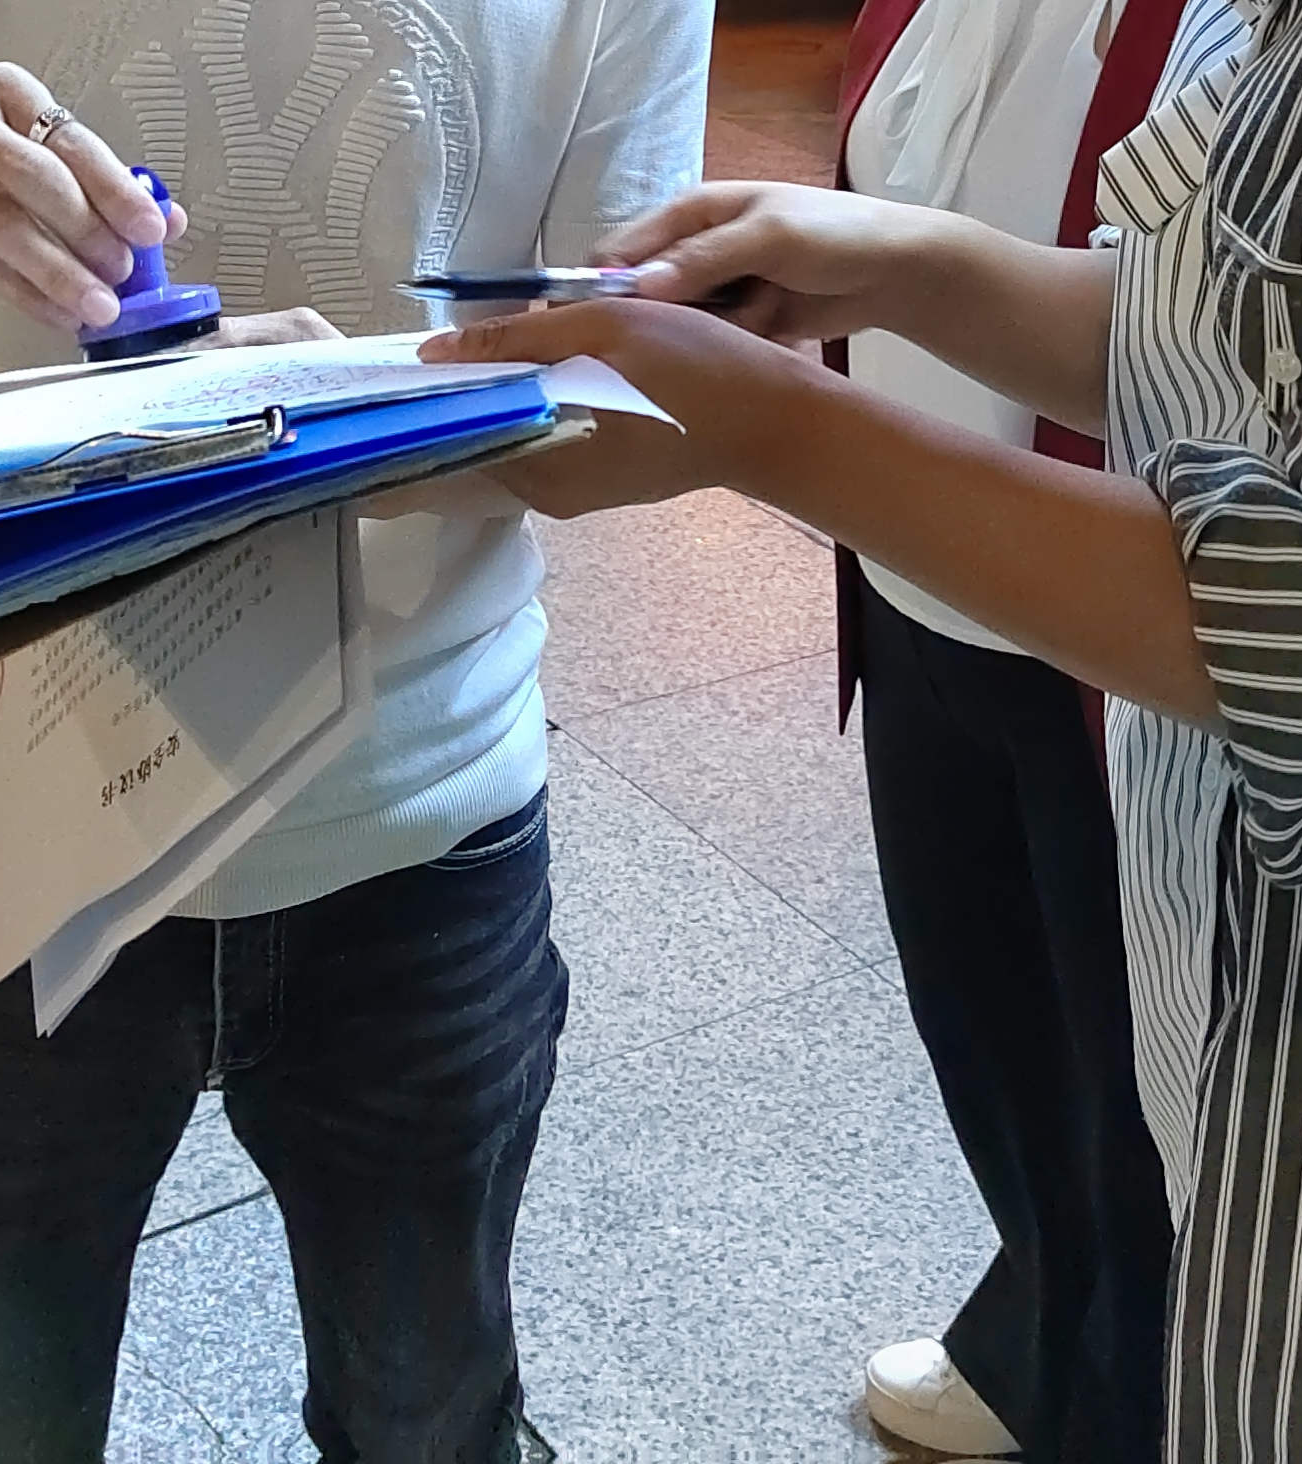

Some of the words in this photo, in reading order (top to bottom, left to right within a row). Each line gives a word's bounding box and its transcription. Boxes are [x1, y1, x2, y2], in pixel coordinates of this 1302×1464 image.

[101, 728, 180, 807] 安全协议书
